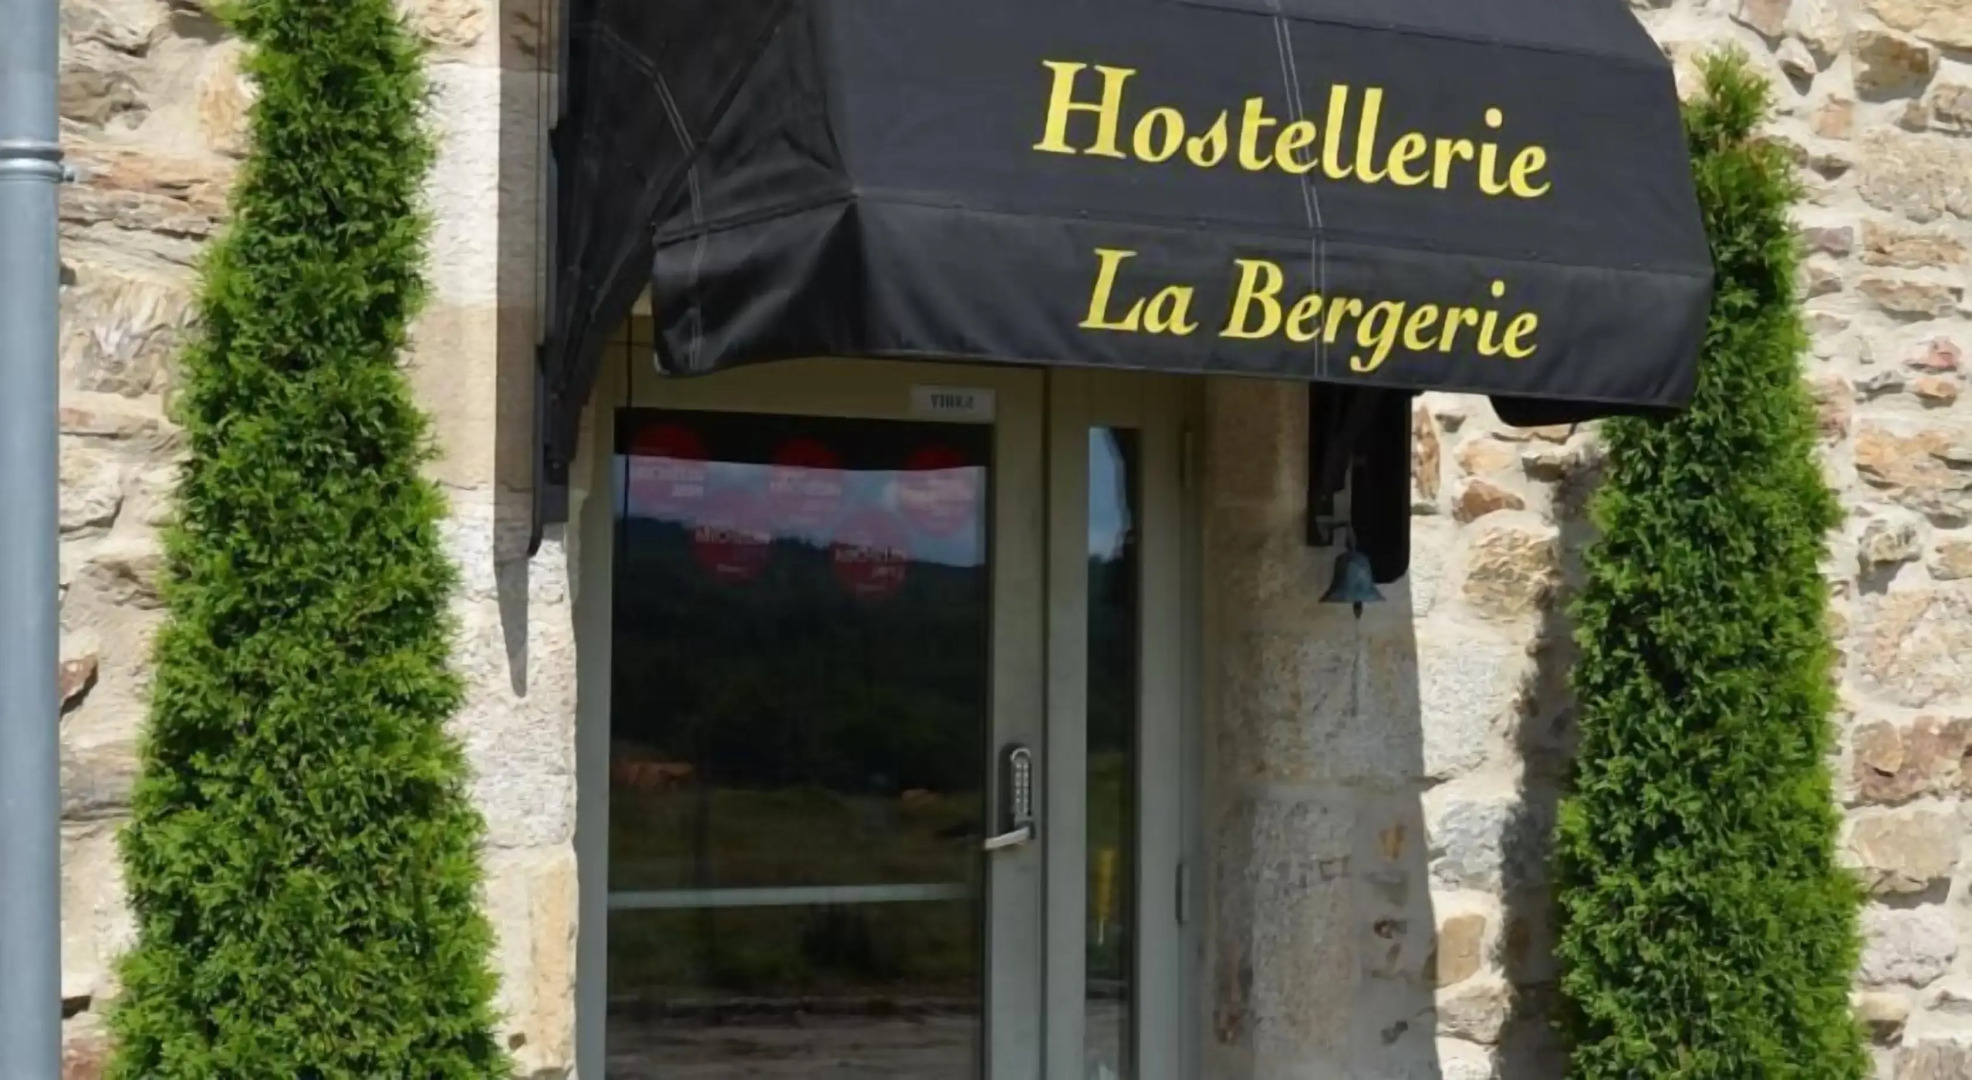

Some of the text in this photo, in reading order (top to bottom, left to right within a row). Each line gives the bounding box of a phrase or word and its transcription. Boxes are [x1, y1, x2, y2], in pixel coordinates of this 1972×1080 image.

[1033, 60, 1550, 198] Hostellerie
[1079, 248, 1539, 373] La Bergerie
